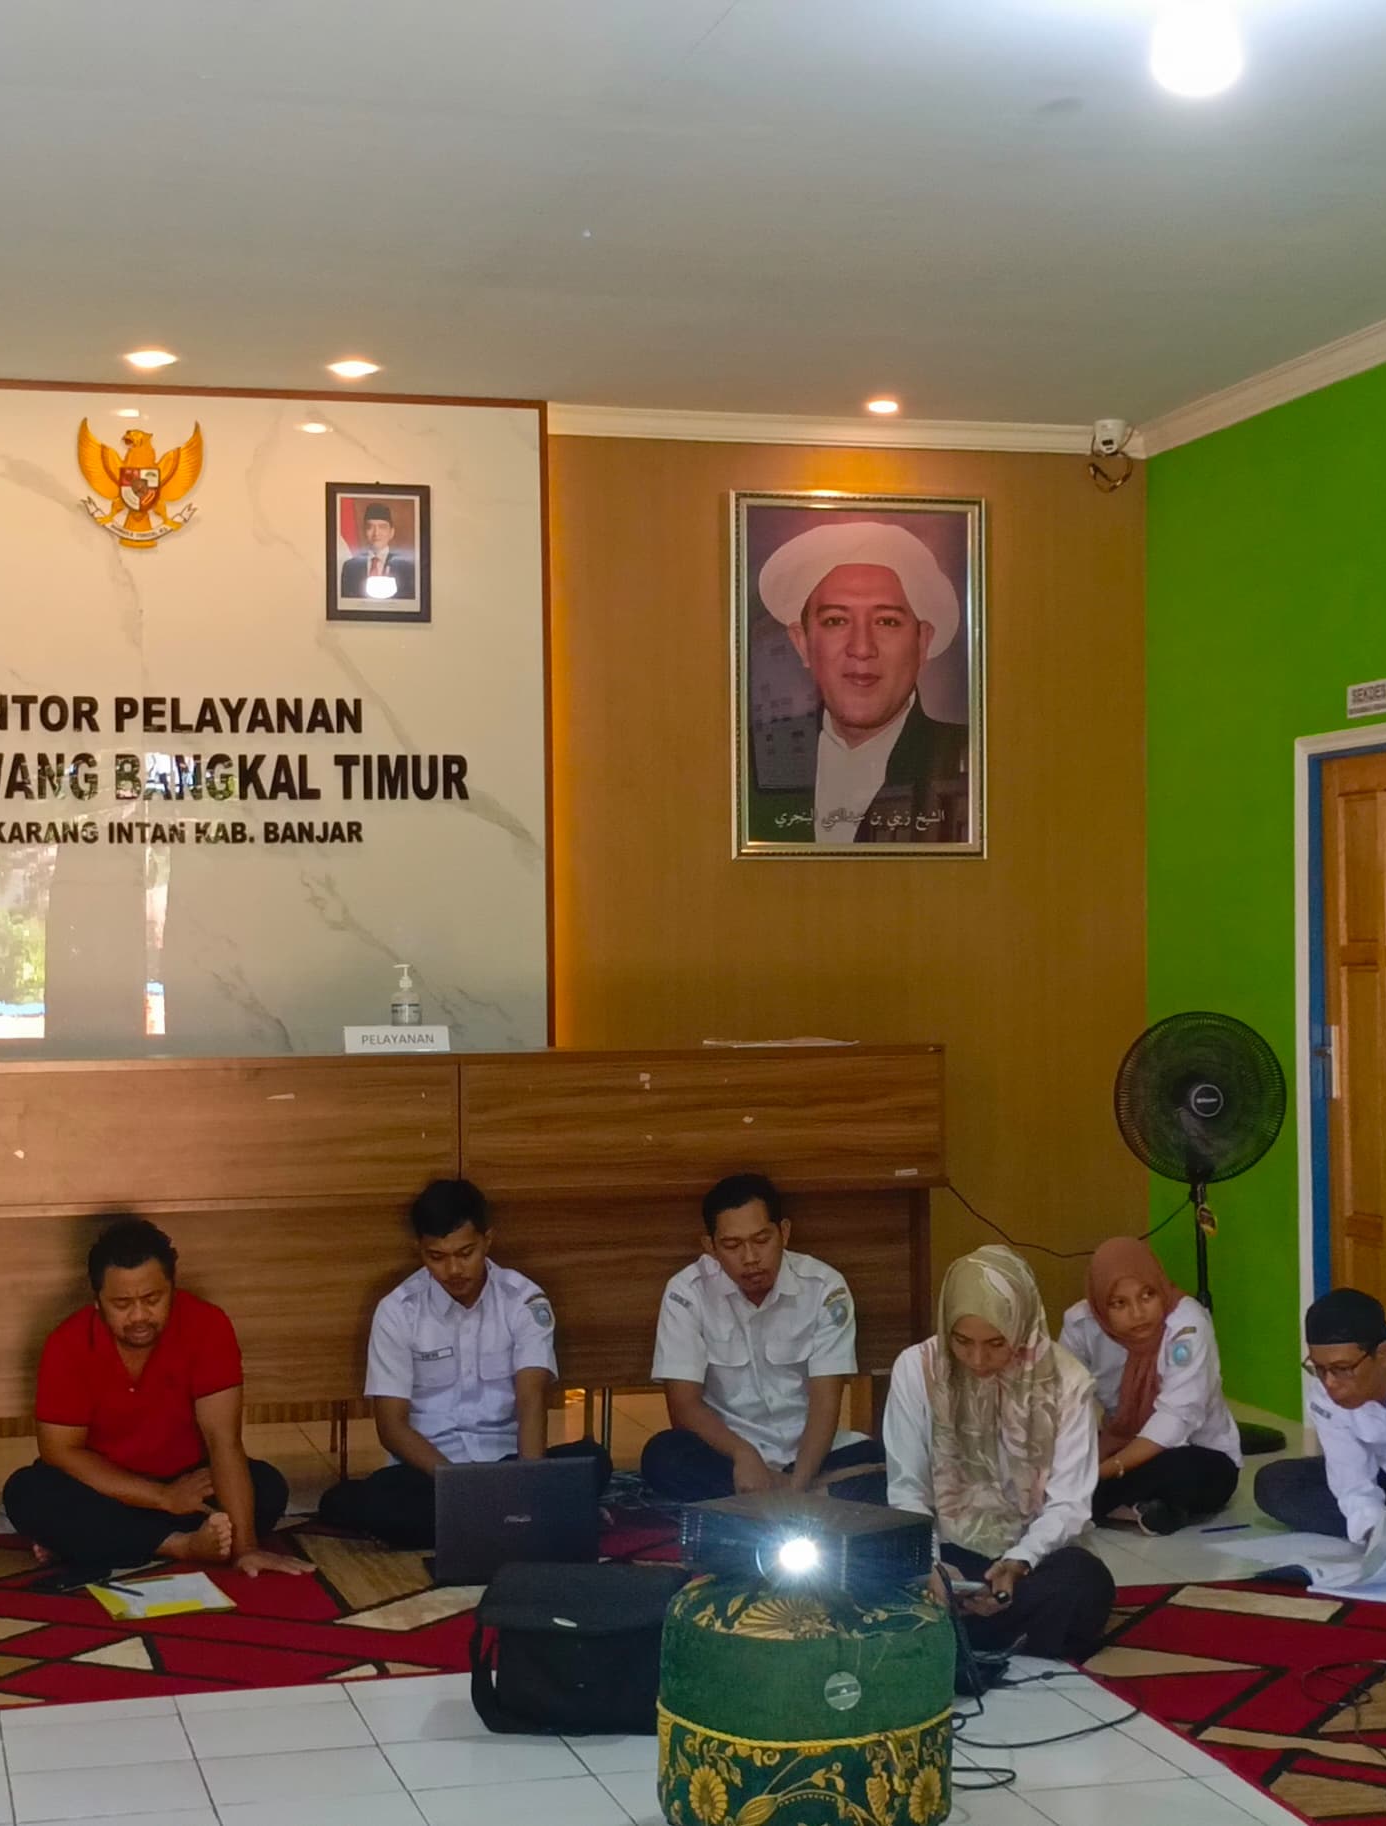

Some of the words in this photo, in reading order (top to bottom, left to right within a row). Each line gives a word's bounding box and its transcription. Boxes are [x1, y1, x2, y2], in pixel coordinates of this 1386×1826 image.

[115, 697, 362, 734] PELAYANAN
[115, 754, 321, 801] BANGKAL
[334, 754, 470, 801] TIMUR
[108, 821, 186, 844] INTAN
[194, 821, 255, 844] KAB.
[263, 821, 364, 844] BANJAR
[361, 1034, 434, 1045] PELAYANAN
